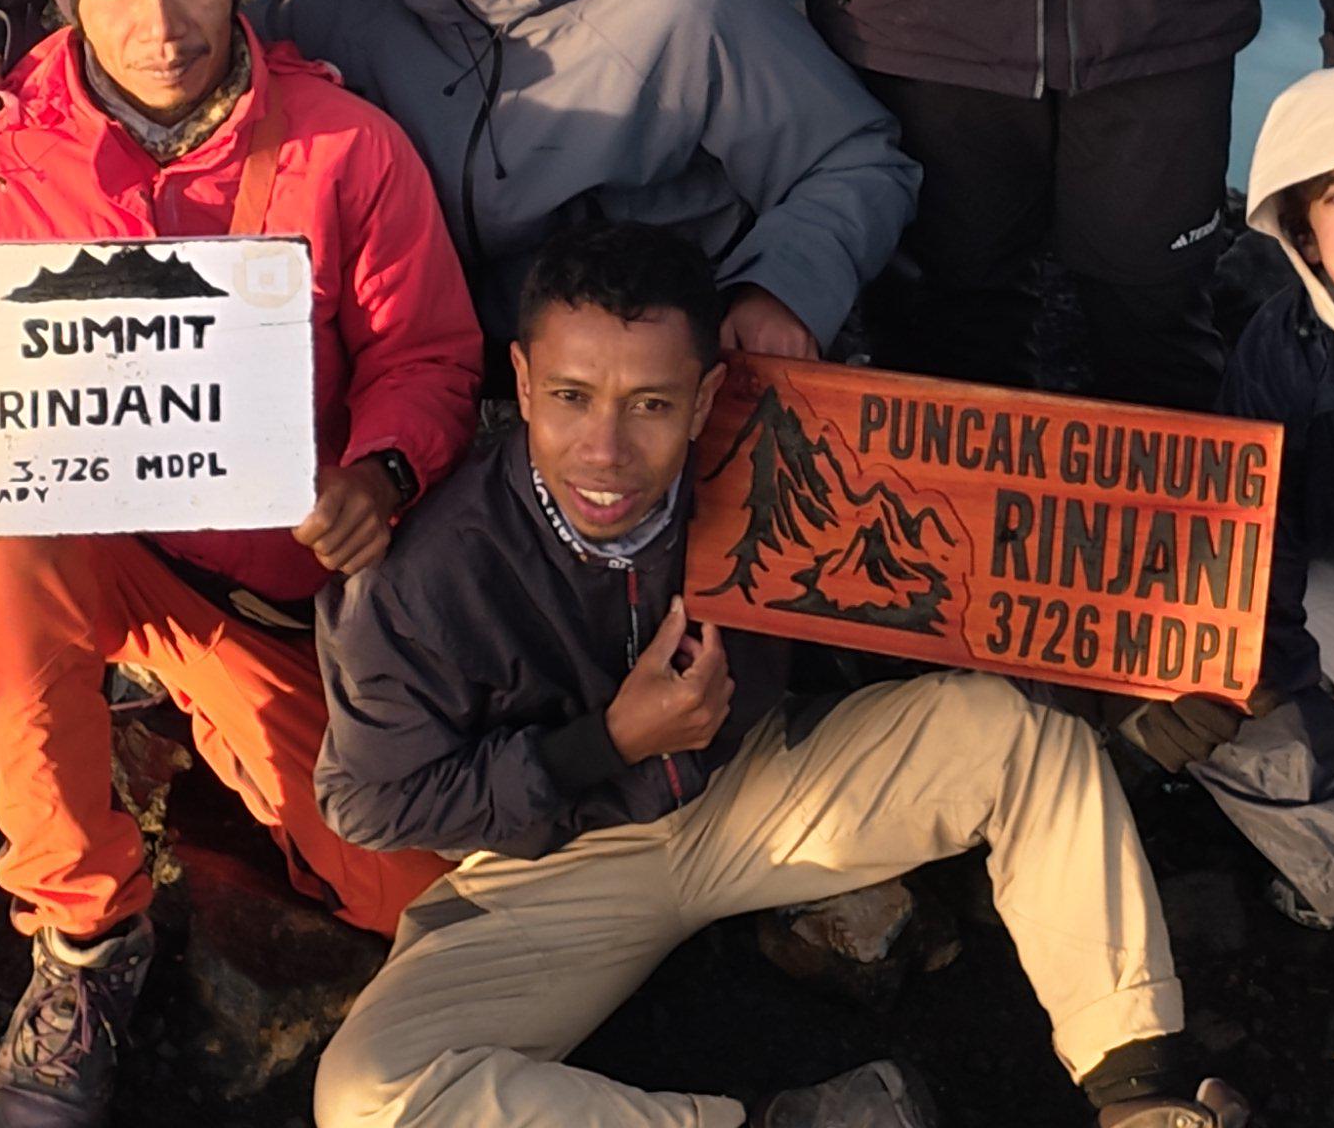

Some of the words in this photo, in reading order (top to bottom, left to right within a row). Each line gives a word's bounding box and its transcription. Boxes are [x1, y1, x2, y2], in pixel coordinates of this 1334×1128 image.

[21, 315, 216, 359] SUMMIT
[8, 458, 110, 483] 3.726
[137, 452, 227, 480] MDPL
[858, 393, 1050, 480] PUNCAK
[1059, 420, 1267, 510] GUNUNG
[990, 487, 1260, 613] RINJANI
[985, 590, 1101, 669] 3726
[1112, 610, 1244, 691] MDPL
